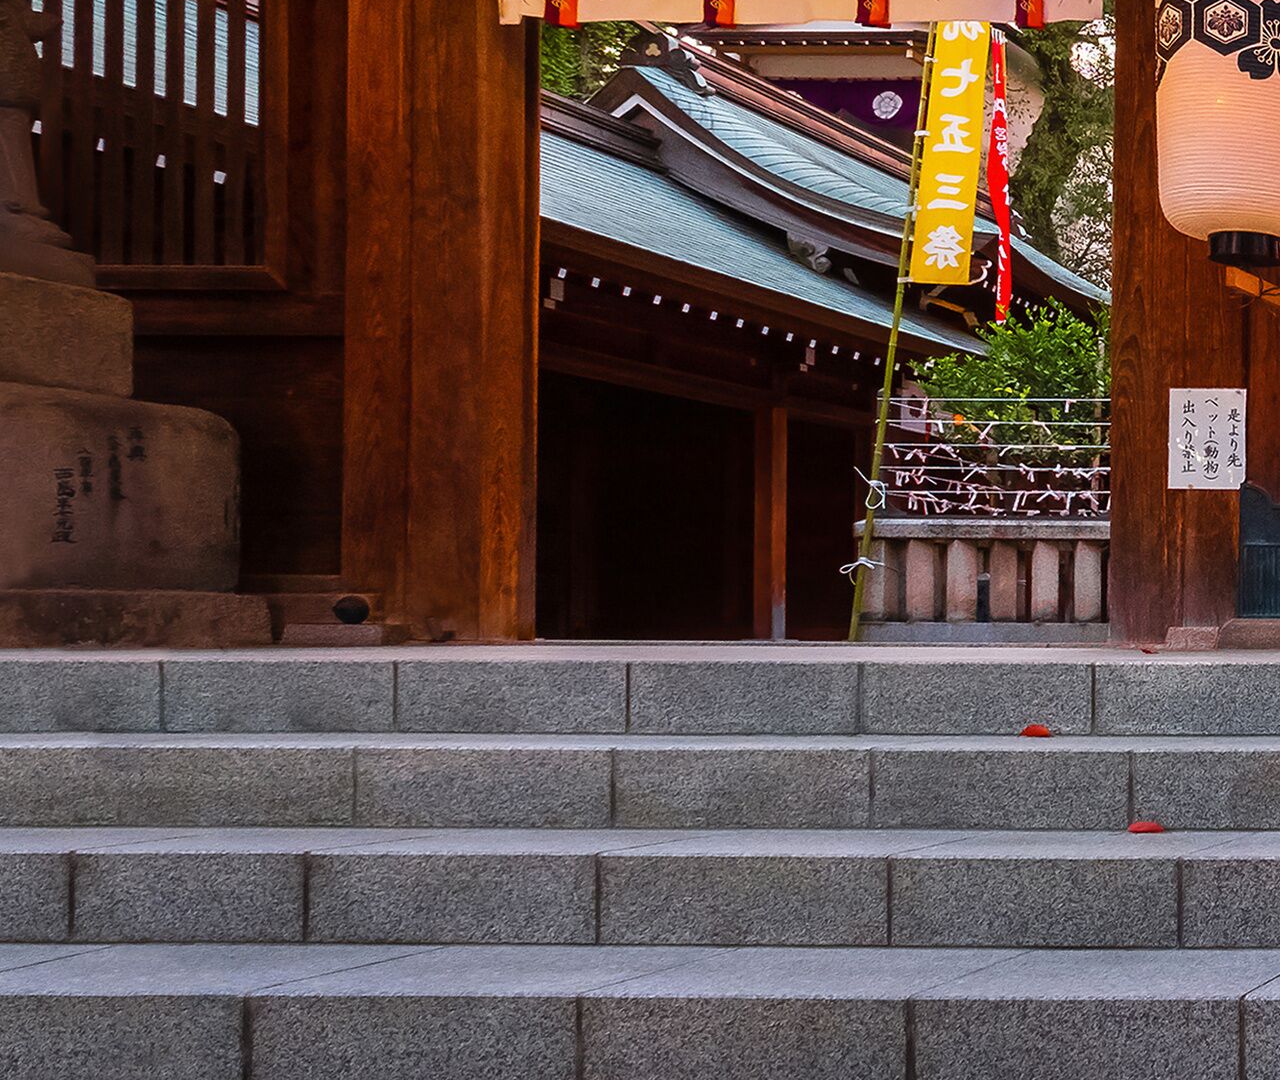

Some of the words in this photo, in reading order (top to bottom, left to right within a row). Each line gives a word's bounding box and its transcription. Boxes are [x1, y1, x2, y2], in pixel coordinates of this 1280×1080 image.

[1181, 399, 1197, 474] 出入り禁止
[1226, 408, 1243, 468] 是より先
